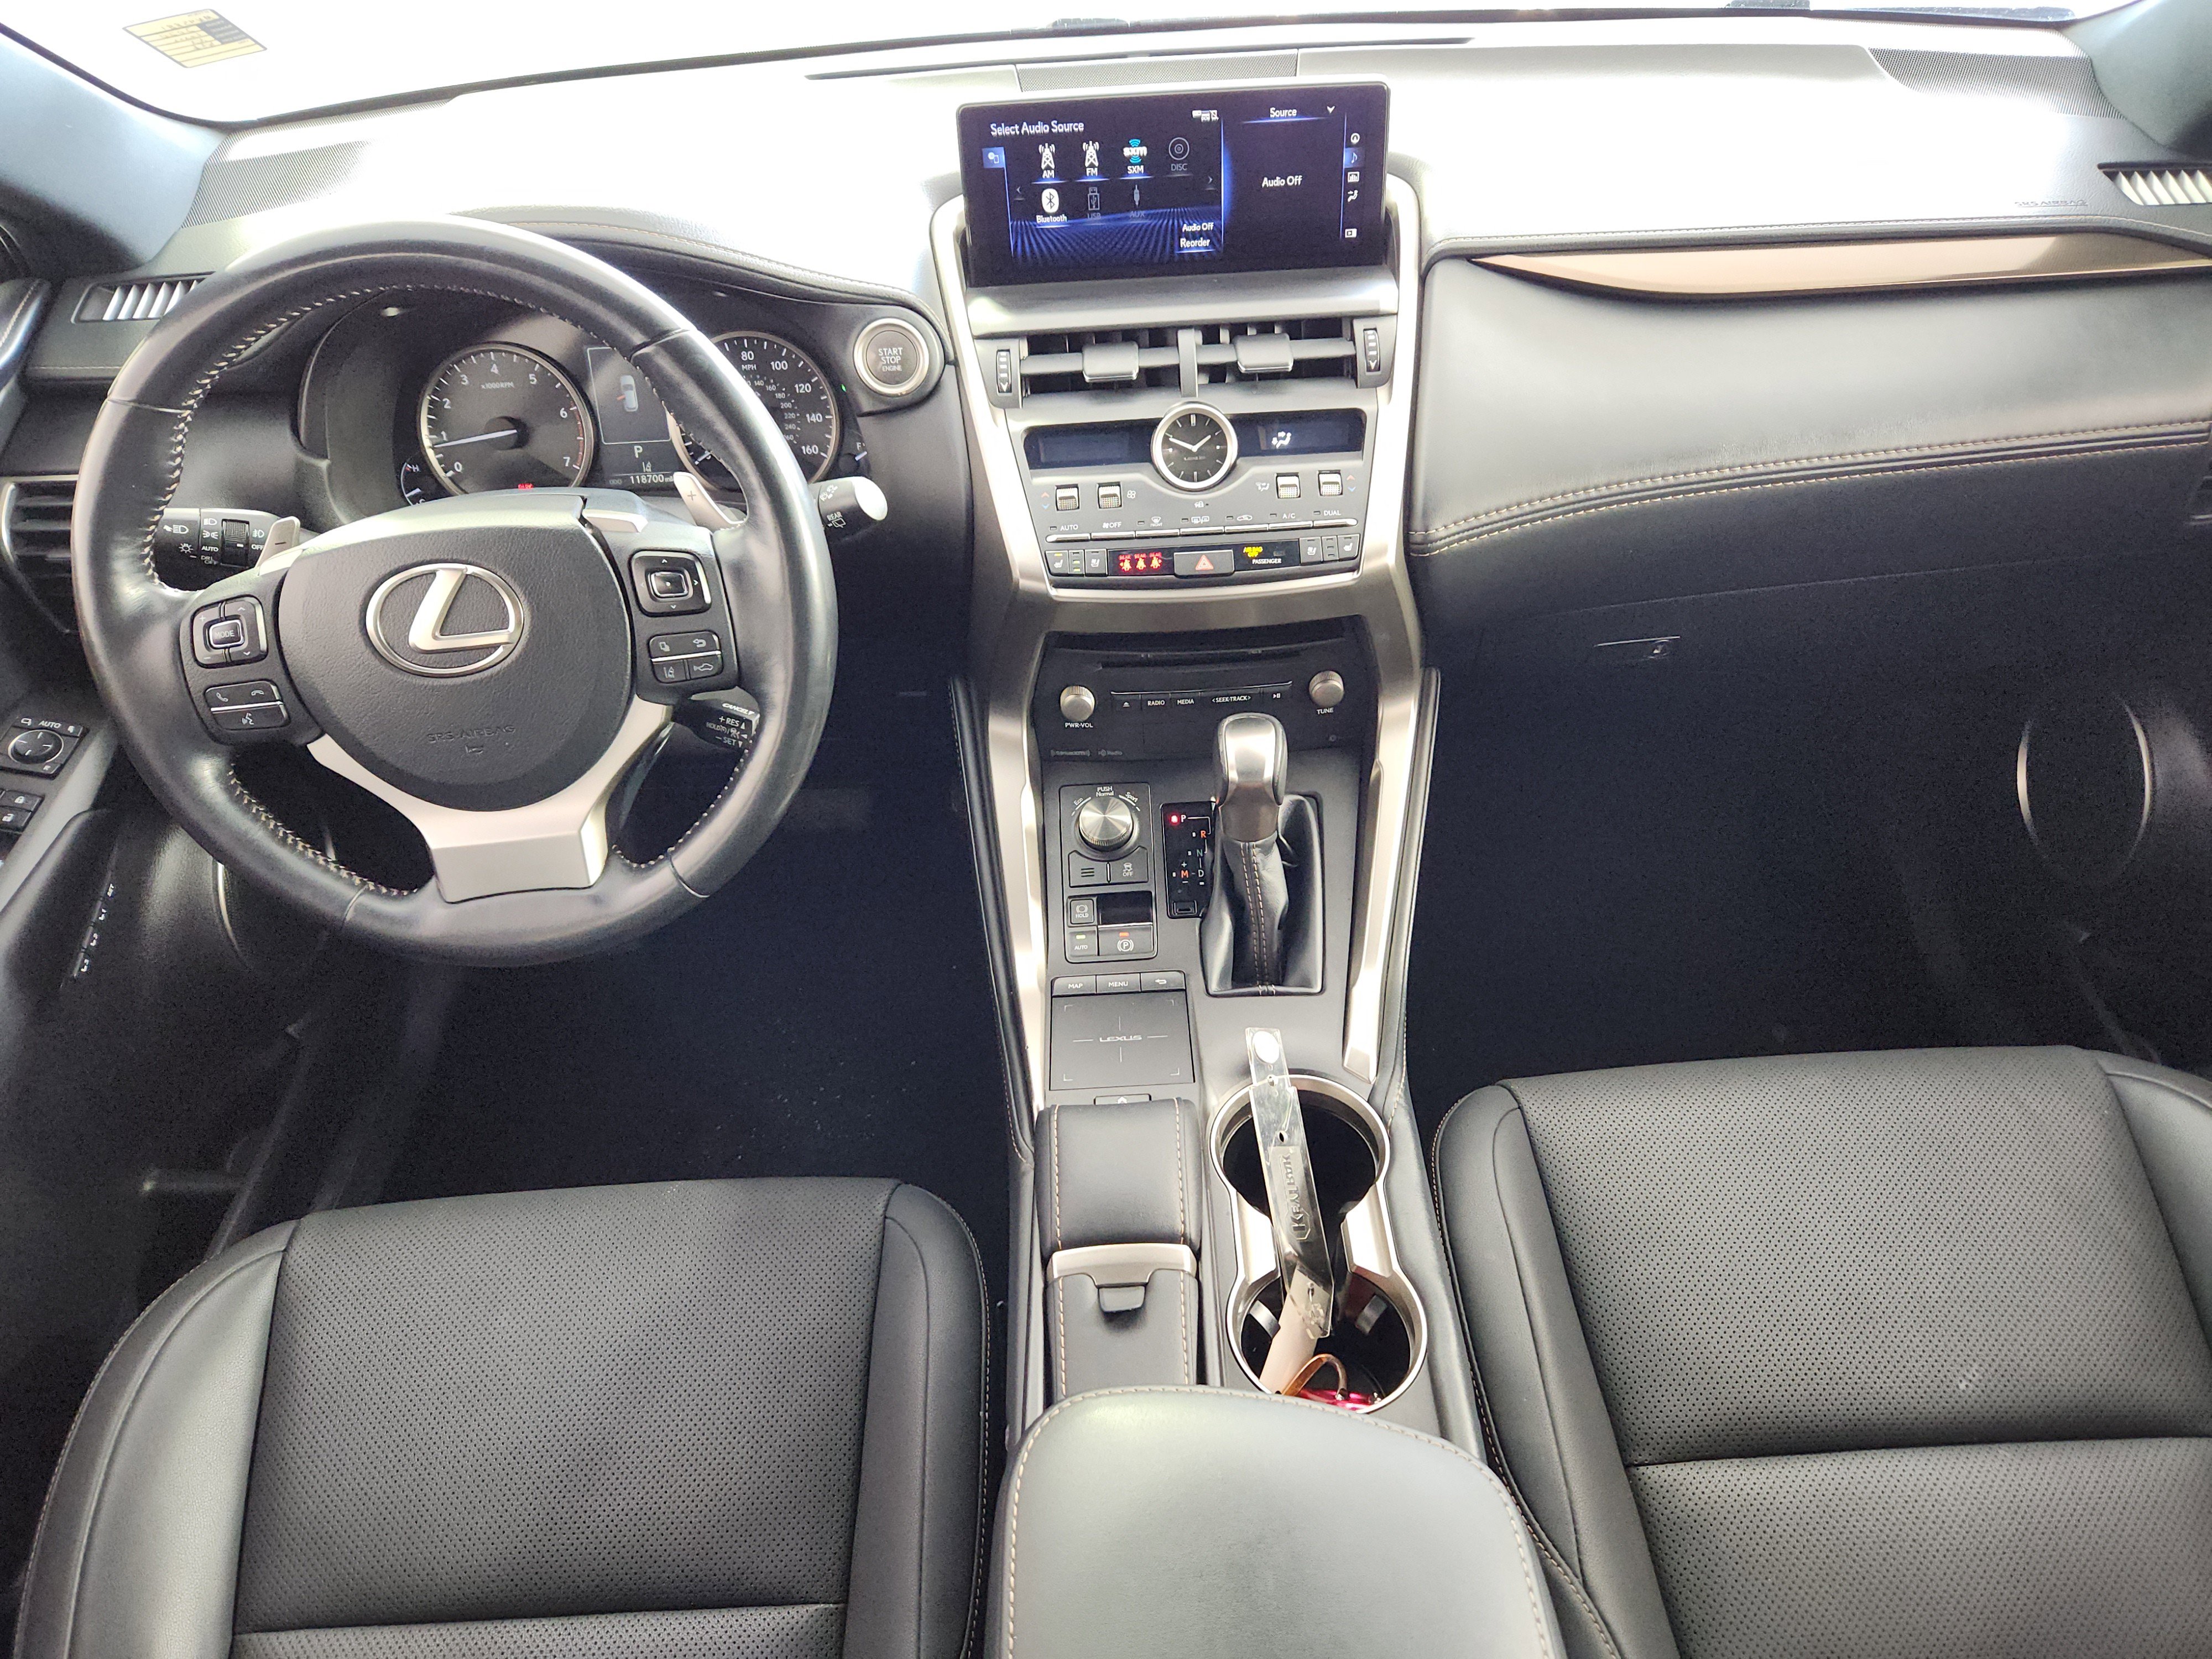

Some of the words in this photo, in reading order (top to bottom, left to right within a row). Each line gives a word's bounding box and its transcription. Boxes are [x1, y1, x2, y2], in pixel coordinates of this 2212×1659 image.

[1270, 107, 1297, 117] Source
[990, 123, 1019, 136] Select
[1021, 121, 1049, 135] Audio
[1051, 120, 1084, 133] Source
[1086, 168, 1098, 176] FM
[1128, 165, 1144, 174] SXM
[1262, 176, 1285, 187] Audio
[1287, 175, 1302, 185] Off
[1036, 215, 1067, 223] Bluetooth
[1182, 223, 1201, 232] Audio
[1202, 222, 1214, 231] Off
[1180, 238, 1210, 248] Reorder
[741, 351, 754, 361] 80
[879, 347, 903, 356] START
[881, 356, 901, 364] STOP
[491, 363, 500, 375] 4
[770, 361, 788, 371] 100
[460, 374, 468, 385] 3
[529, 373, 537, 384] 5
[794, 383, 812, 394] 120
[443, 398, 451, 409] 2
[560, 408, 568, 418] 6
[806, 413, 823, 423] 140
[441, 431, 447, 441] 1
[634, 445, 643, 458] P
[801, 446, 818, 455] 160
[454, 462, 462, 472] 0
[563, 457, 570, 467] 7
[411, 464, 419, 472] H
[630, 474, 664, 484] 118700
[827, 512, 843, 521] REAR
[215, 629, 235, 638] MODE
[38, 720, 62, 729] AUTO
